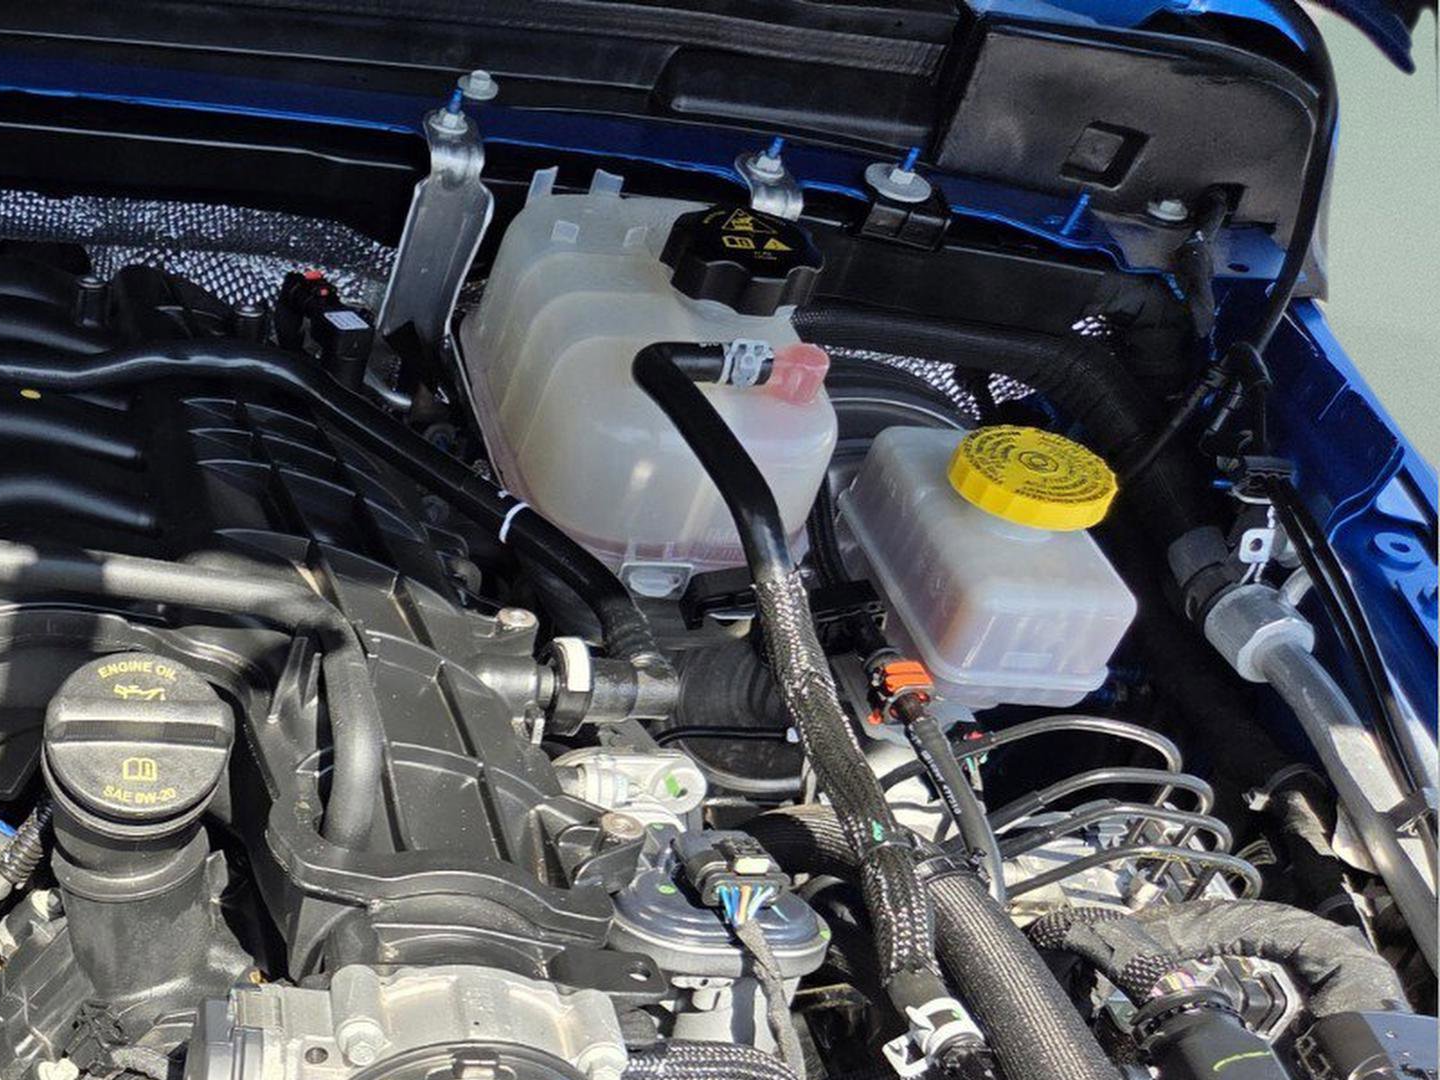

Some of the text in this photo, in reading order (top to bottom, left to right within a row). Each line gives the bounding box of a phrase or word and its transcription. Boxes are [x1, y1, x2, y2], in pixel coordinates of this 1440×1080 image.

[98, 661, 177, 682] ENGINE OIL
[103, 785, 134, 800] SAE
